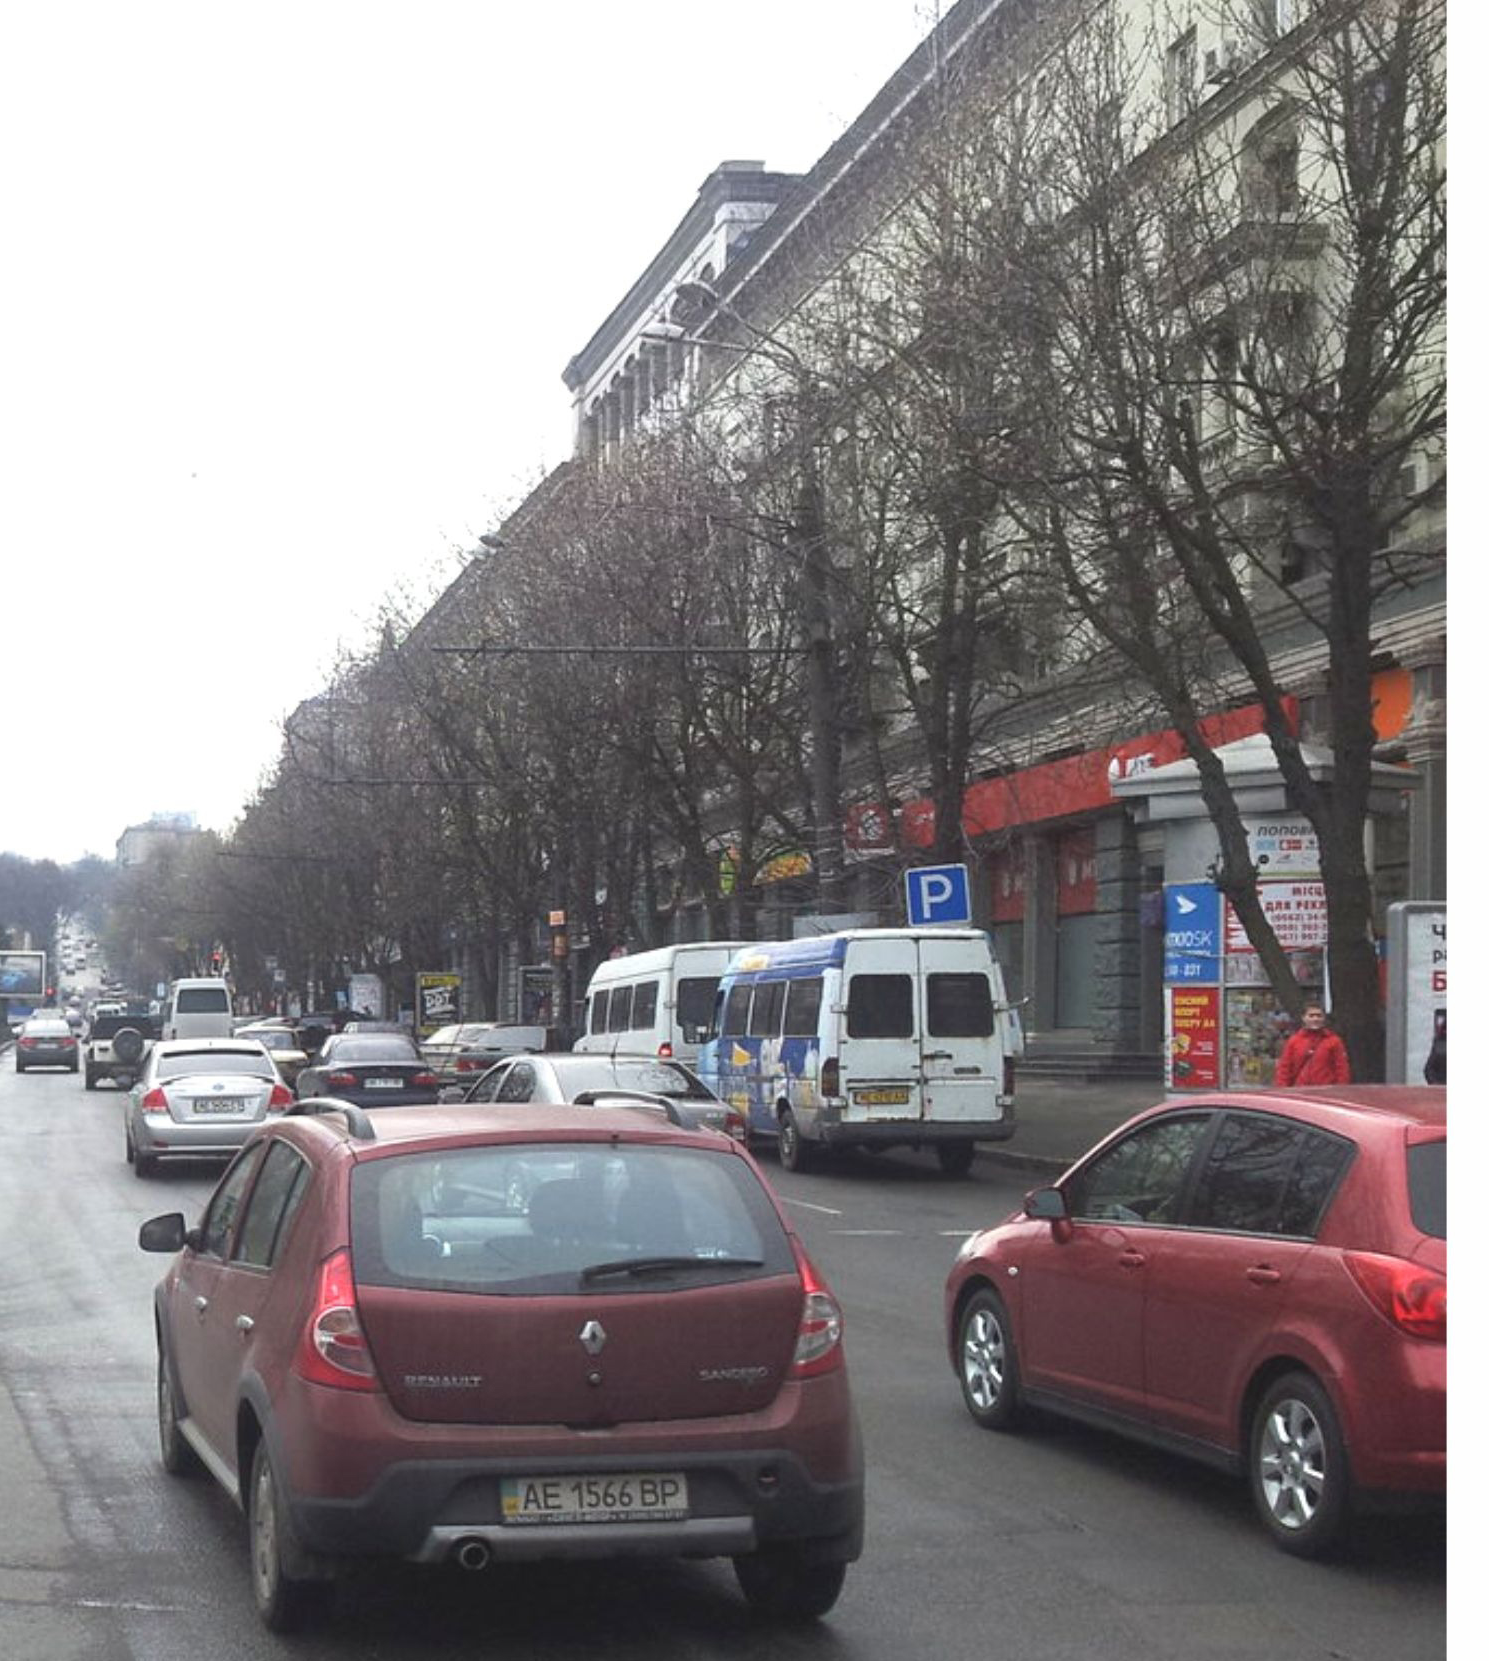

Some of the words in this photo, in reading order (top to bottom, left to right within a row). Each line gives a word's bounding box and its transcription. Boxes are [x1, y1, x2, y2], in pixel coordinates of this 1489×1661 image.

[919, 873, 953, 919] P
[404, 1375, 483, 1388] RENAULT
[699, 1366, 769, 1382] SANDERO
[523, 1482, 563, 1510] AE
[571, 1480, 634, 1509] 1566
[640, 1479, 679, 1507] BP
